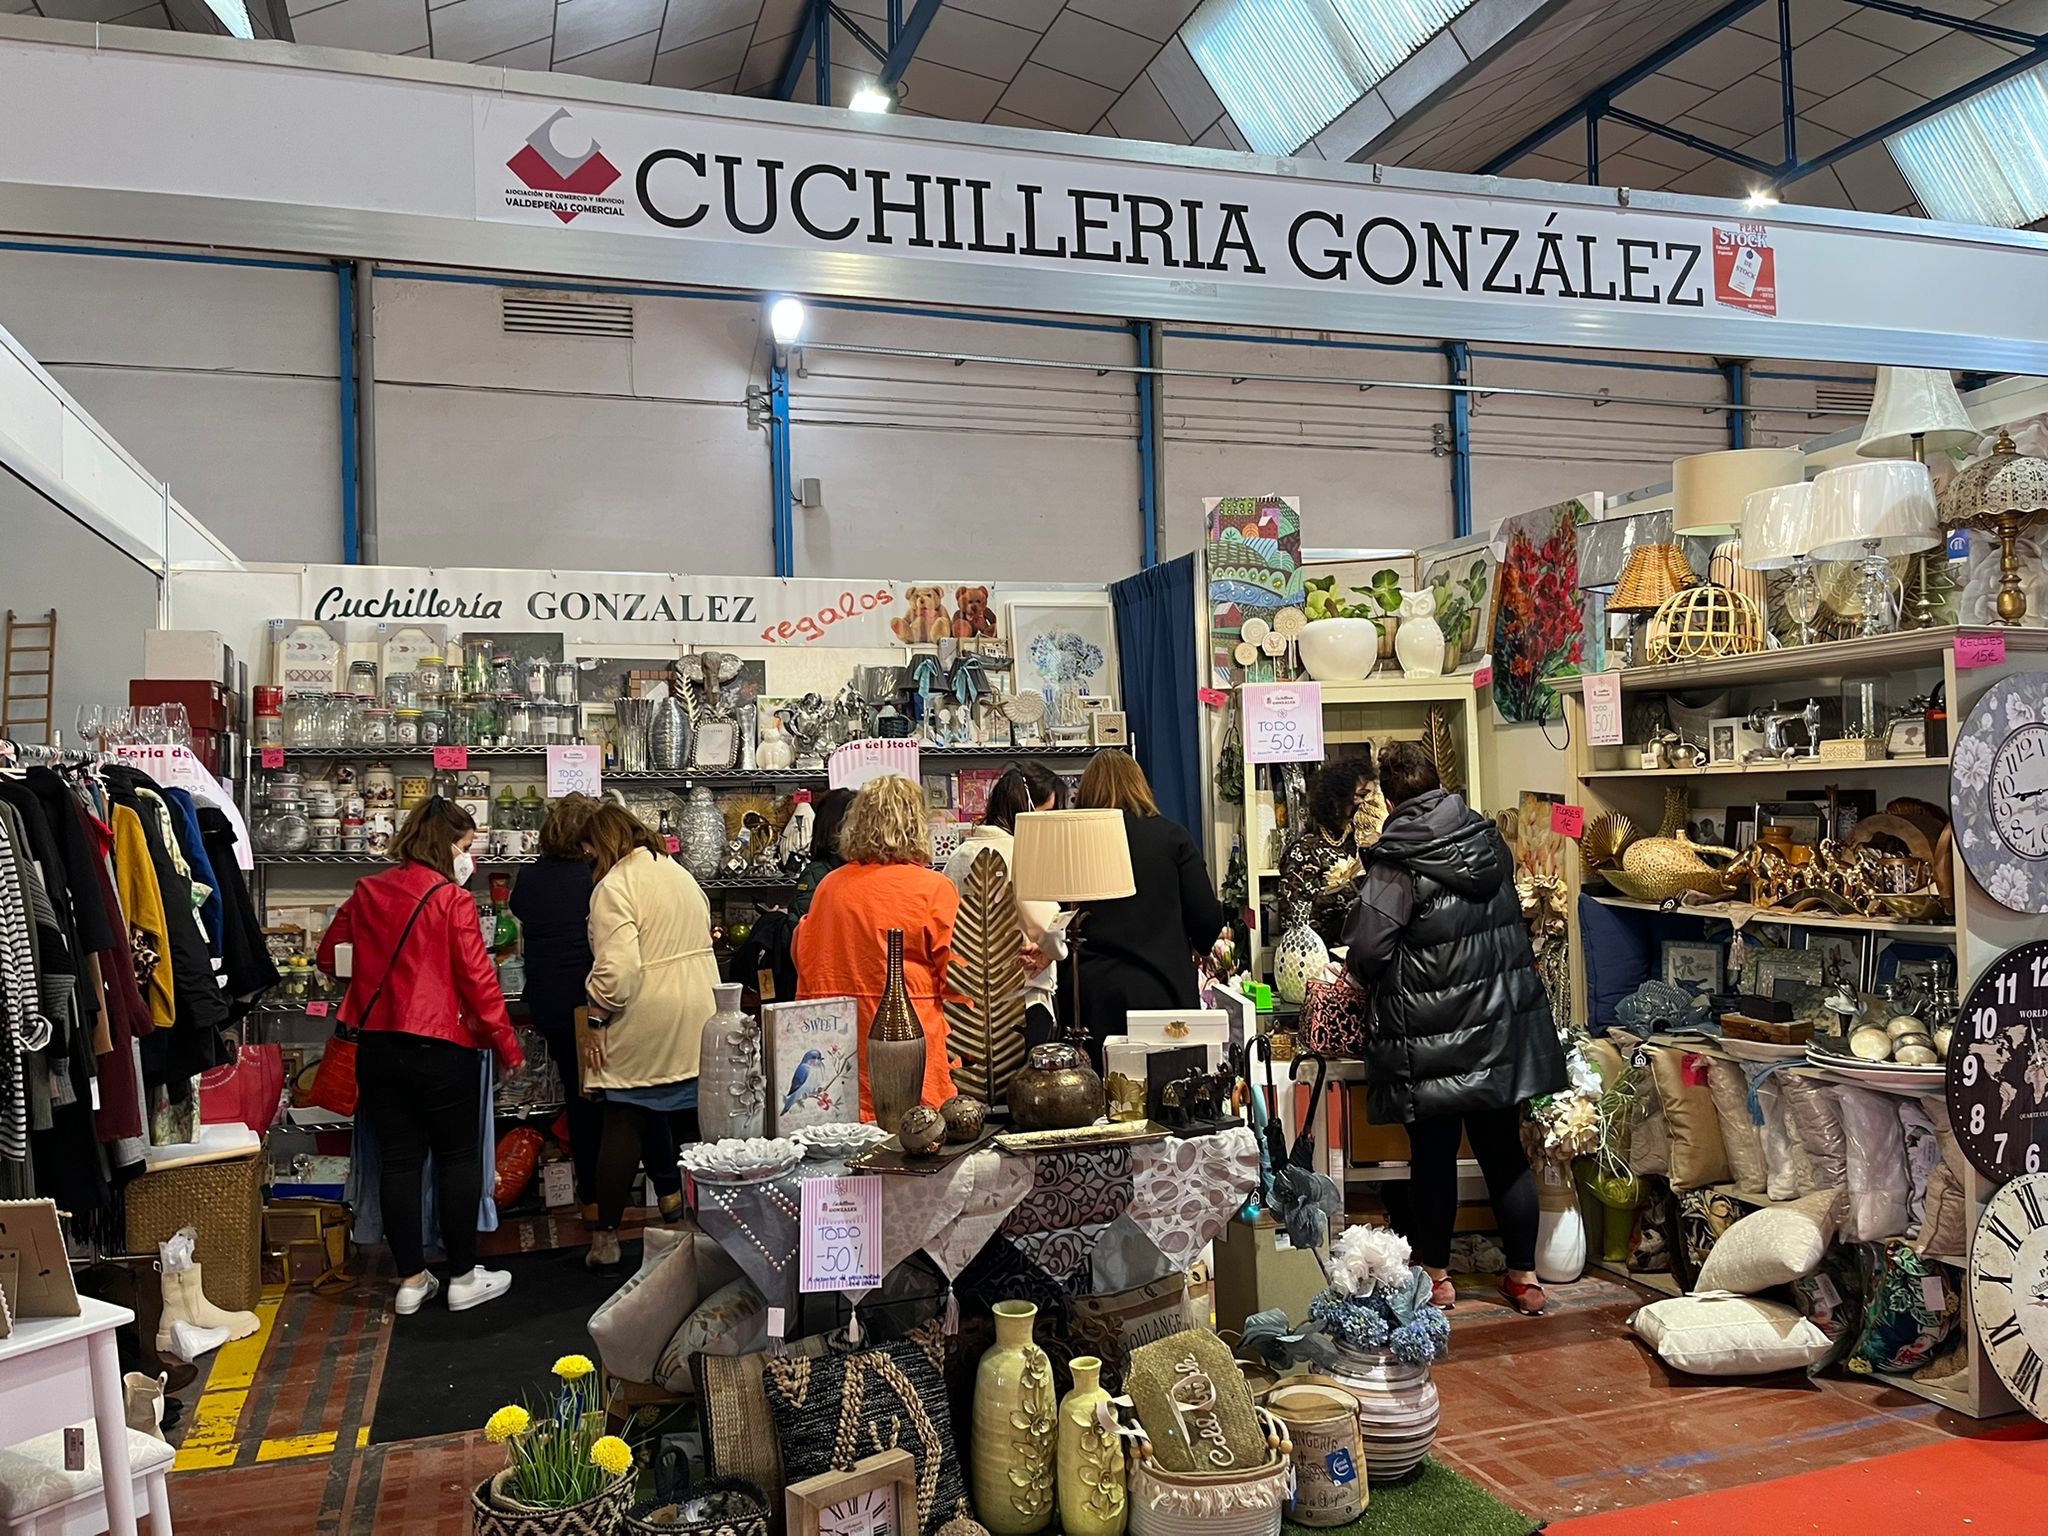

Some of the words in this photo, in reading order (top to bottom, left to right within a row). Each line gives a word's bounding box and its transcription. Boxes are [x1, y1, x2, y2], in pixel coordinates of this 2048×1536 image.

[505, 188, 543, 197] ASOCIACIÓN
[555, 193, 587, 201] COMERCIO
[595, 196, 625, 205] SERVICIOS
[505, 197, 568, 211] VALDEPEÑAS
[570, 203, 625, 216] COMERCIAL
[635, 148, 1266, 274] CUCHILLERIA
[1287, 210, 1705, 308] GONZÁLEZ
[1719, 231, 1768, 248] STOCK
[315, 585, 502, 624] Cuchillería
[527, 590, 757, 625] GONZALEZ
[760, 586, 893, 645] regalos
[1258, 721, 1296, 732] TODO
[117, 747, 163, 759] Feria
[887, 740, 918, 749] Stock
[557, 769, 583, 778] TODO
[1995, 972, 2017, 1005] 11
[801, 1014, 842, 1033] SWEET
[1971, 1007, 1997, 1040] 10
[1962, 1054, 1978, 1087] 9
[1969, 1103, 1985, 1135] 8
[1993, 1132, 2009, 1164] 7
[2025, 1143, 2041, 1174] 6
[818, 1226, 861, 1240] TODO
